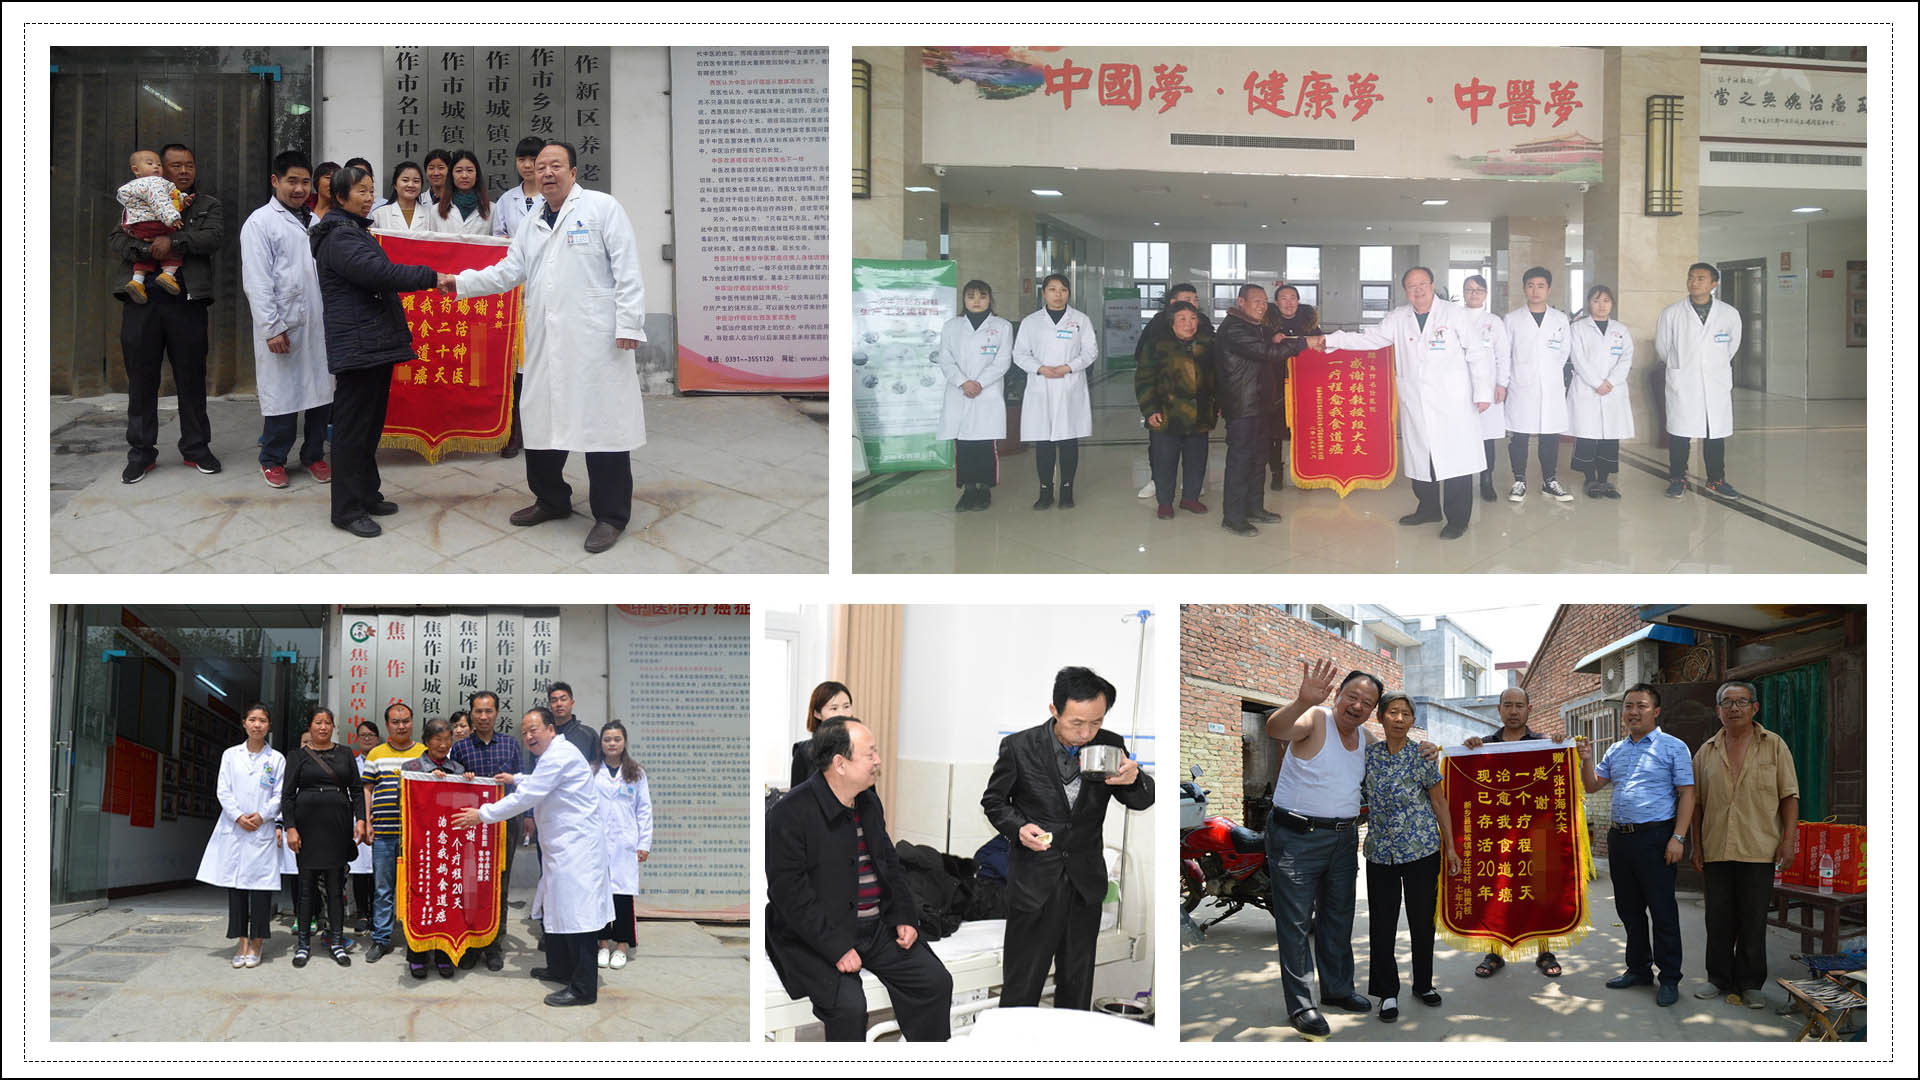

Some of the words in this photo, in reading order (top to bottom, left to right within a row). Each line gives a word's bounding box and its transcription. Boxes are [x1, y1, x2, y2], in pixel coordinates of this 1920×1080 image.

[395, 46, 420, 158] 作市名仕中
[486, 51, 511, 191] 作市城镇居民
[575, 55, 600, 182] 作新区养老
[1043, 58, 1193, 114] 中國夢
[1243, 69, 1384, 121] 健康夢
[1455, 76, 1584, 128] 中醫夢
[433, 295, 452, 384] 药二十天
[386, 621, 406, 705] 焦作
[422, 621, 442, 730] 焦作市城镇
[496, 620, 515, 734] 焦作市新区养
[1477, 769, 1496, 902] 现已存活20年
[1496, 768, 1514, 903] 治愈我食道癌
[1515, 771, 1536, 901] 一个疗程20天
[1533, 765, 1550, 811] 感谢
[1552, 752, 1568, 834] 赠：张中海大夫
